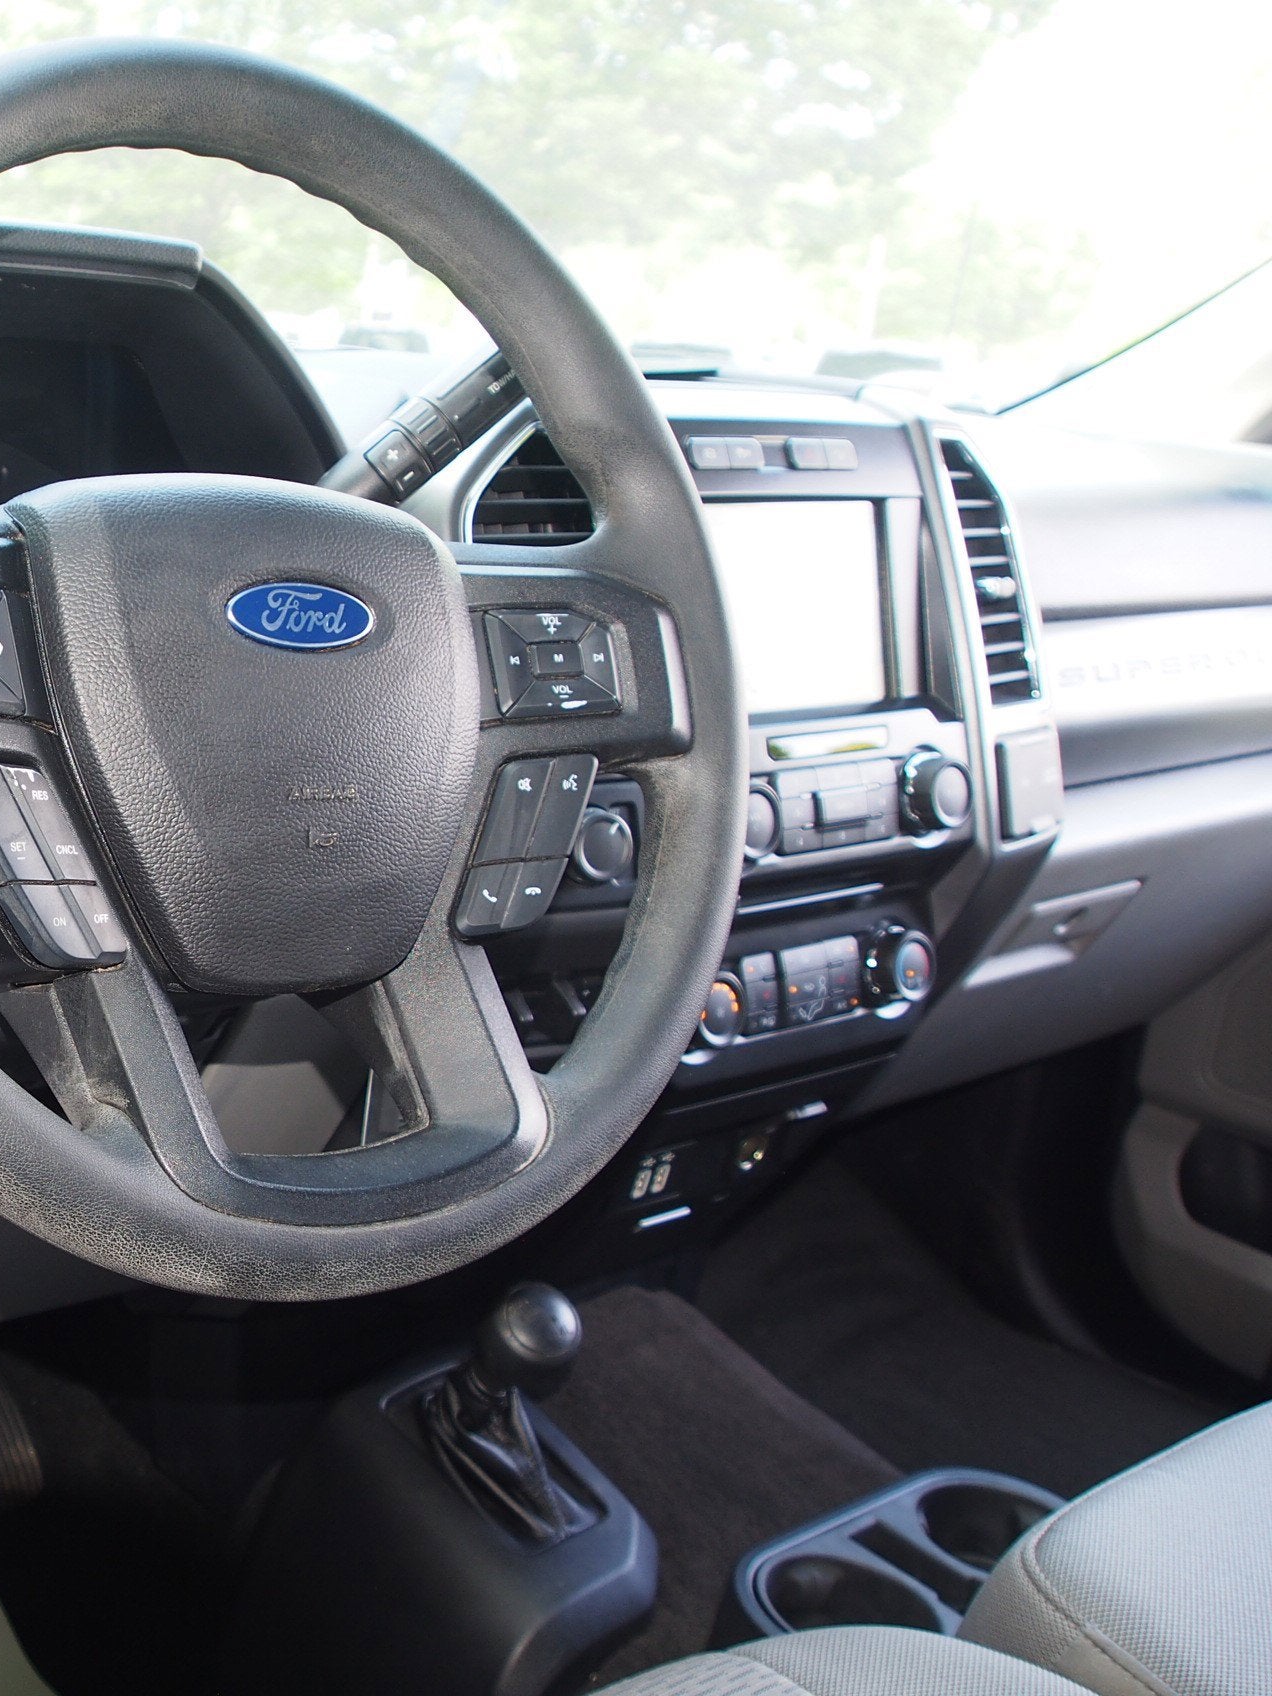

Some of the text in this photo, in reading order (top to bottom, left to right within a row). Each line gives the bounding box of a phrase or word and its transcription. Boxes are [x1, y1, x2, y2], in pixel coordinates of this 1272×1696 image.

[260, 588, 347, 634] Ford
[541, 616, 562, 626] VOL
[554, 653, 564, 663] M
[552, 685, 573, 695] VOL
[31, 789, 49, 801] RES
[10, 841, 27, 853] SET
[55, 844, 79, 856] CNCL
[53, 916, 67, 928] ON
[93, 913, 110, 924] OFF
